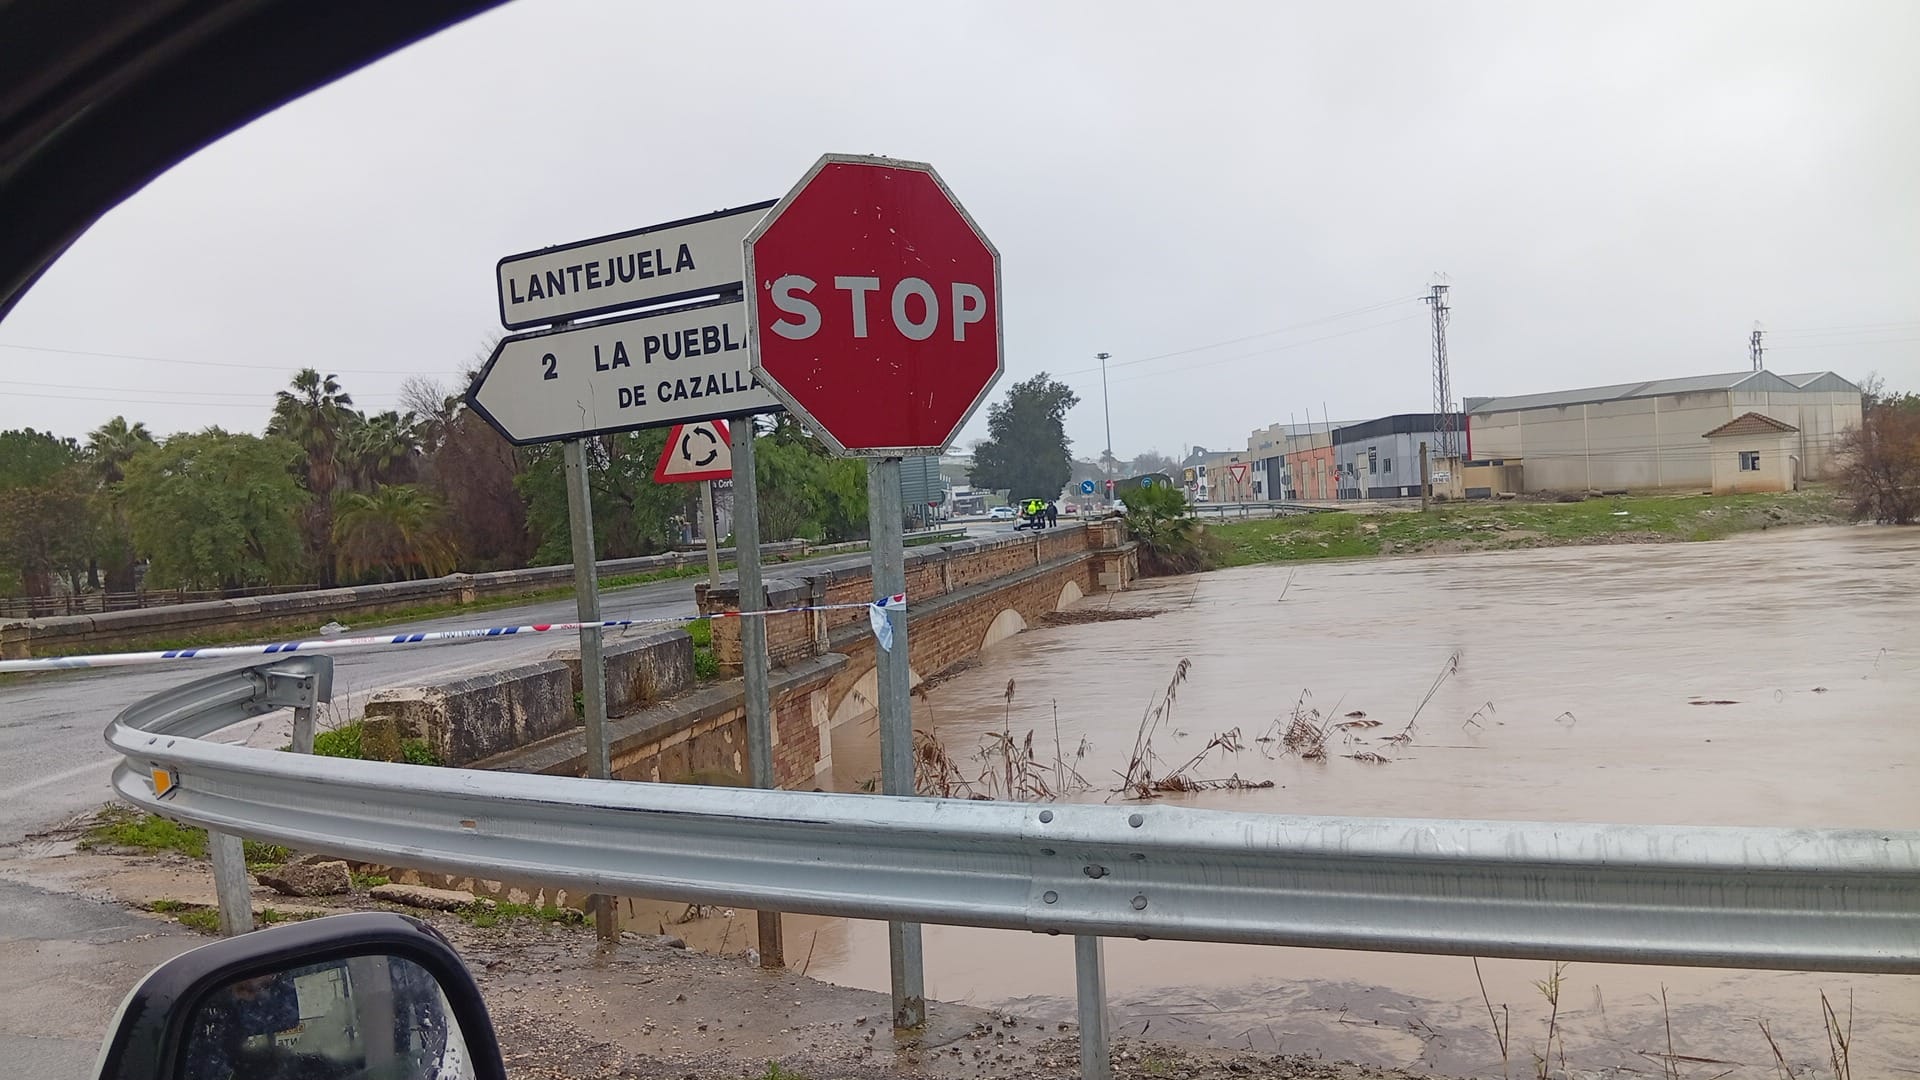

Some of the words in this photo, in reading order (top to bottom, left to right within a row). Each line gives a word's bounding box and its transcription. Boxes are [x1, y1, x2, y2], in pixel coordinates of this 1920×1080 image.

[510, 244, 695, 304] LANTEJUELA
[770, 273, 986, 341] STOP
[542, 353, 558, 380] 2
[594, 341, 630, 372] LA
[644, 323, 748, 364] PUEBL
[618, 385, 646, 408] DE
[658, 370, 764, 402] CAZALLA
